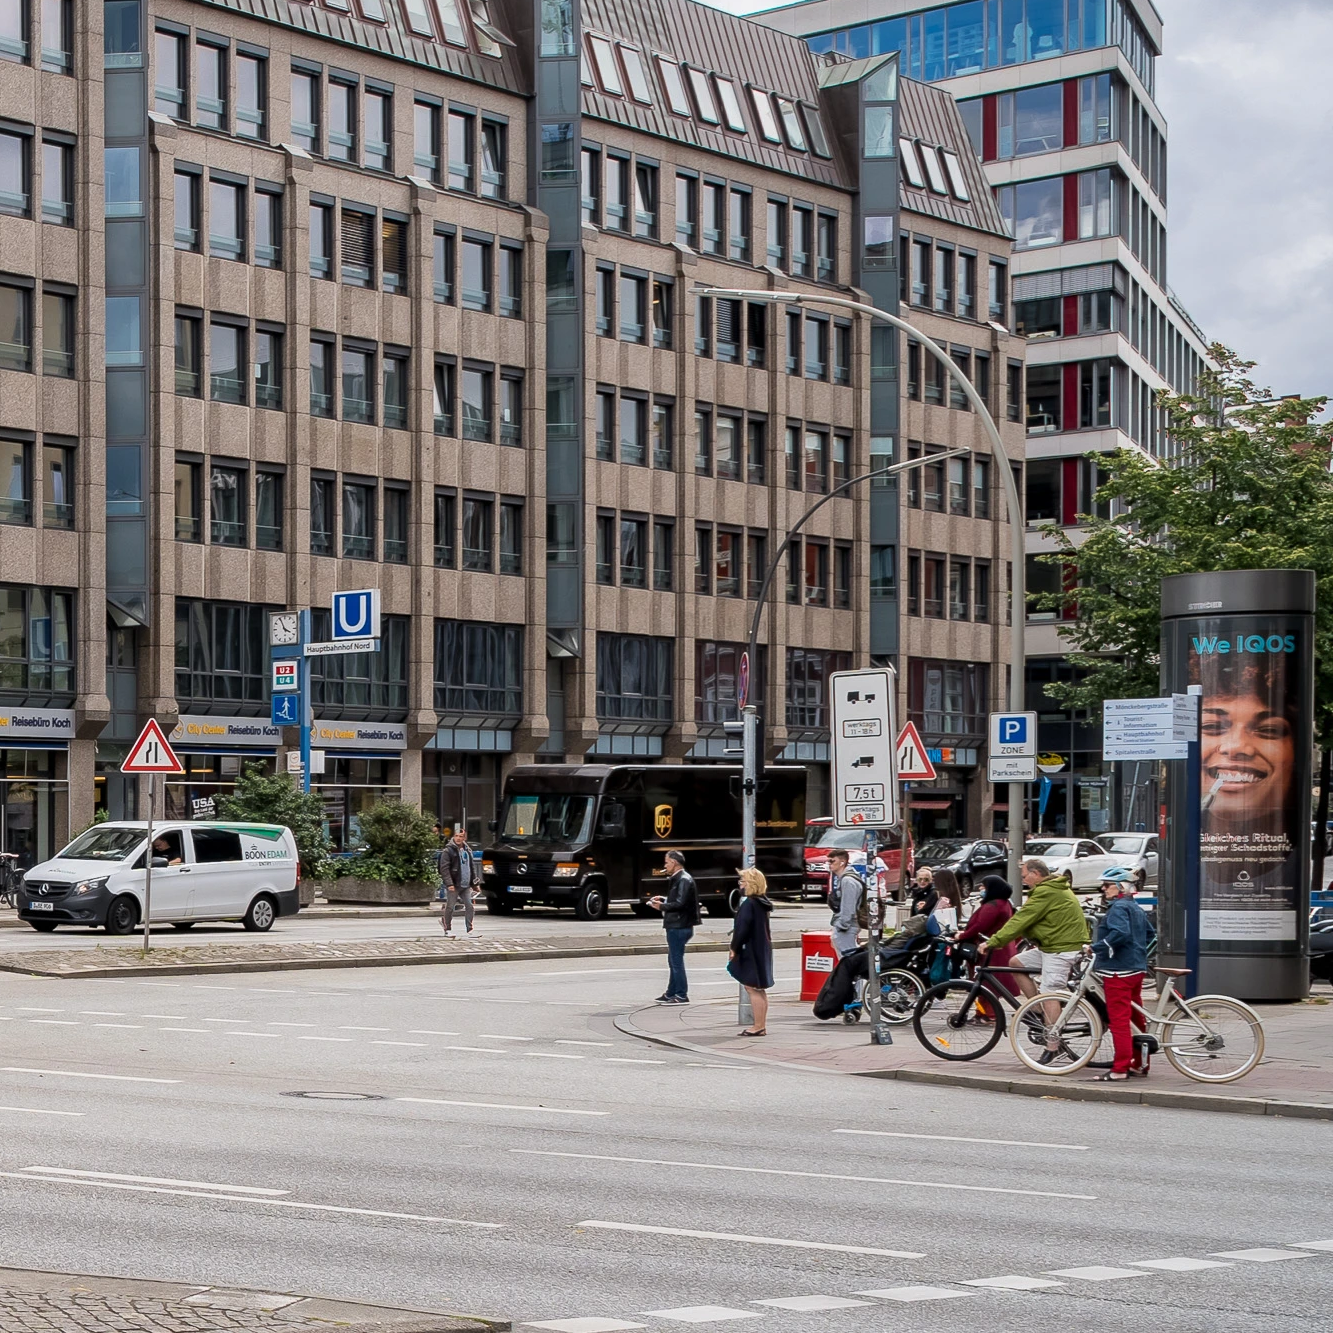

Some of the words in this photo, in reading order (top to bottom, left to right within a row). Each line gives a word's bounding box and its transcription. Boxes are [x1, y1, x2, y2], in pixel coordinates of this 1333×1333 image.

[340, 595, 366, 633] U
[307, 646, 353, 654] Hauptbahnhof
[1193, 636, 1231, 655] We
[1237, 635, 1295, 653] IQOS
[12, 716, 49, 727] Reisebüro
[52, 718, 70, 728] Koch
[847, 721, 876, 729] werktags
[187, 724, 201, 735] City
[203, 724, 225, 734] Center
[228, 725, 261, 736] Reisebüro
[263, 726, 279, 736] Koch
[321, 729, 333, 740] City
[335, 730, 355, 739] Center
[357, 730, 387, 740] Reisebüro
[389, 731, 403, 740] Koch
[1006, 721, 1020, 740] P
[1001, 746, 1025, 754] ZONE
[192, 797, 215, 808] USA
[657, 815, 671, 833] ups
[245, 851, 266, 859] BOON
[267, 850, 287, 858] EDAM
